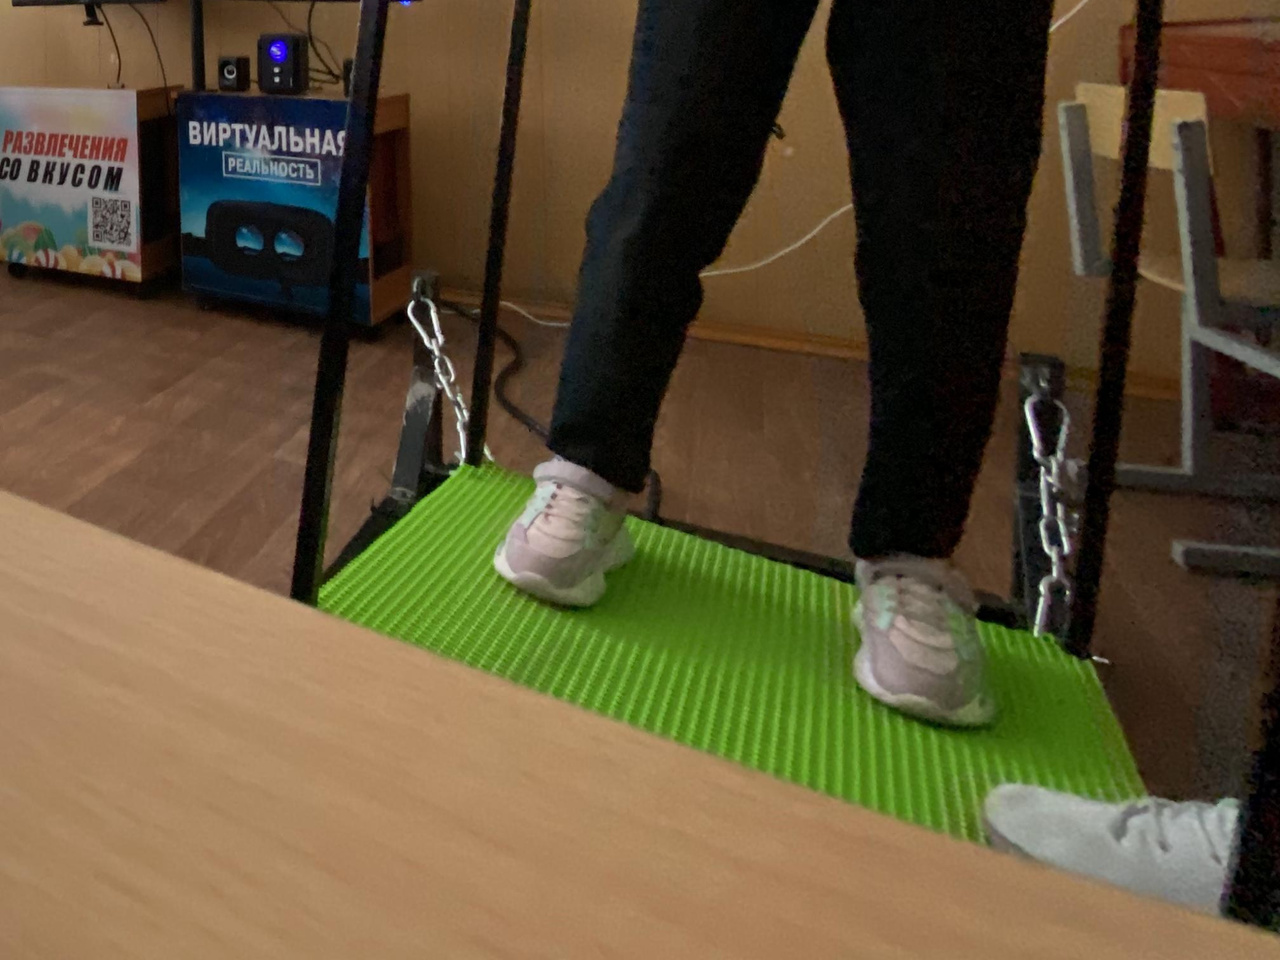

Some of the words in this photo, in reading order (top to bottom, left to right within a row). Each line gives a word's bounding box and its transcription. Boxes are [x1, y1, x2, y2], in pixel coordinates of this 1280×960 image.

[1, 129, 128, 163] РАЗВЛЕЧЕНИЯ
[188, 120, 347, 157] ВИРТУАЛЬНАЯ
[26, 159, 124, 192] ВКУСОМ
[227, 156, 315, 180] РЕАЛЬНОСТЬ
